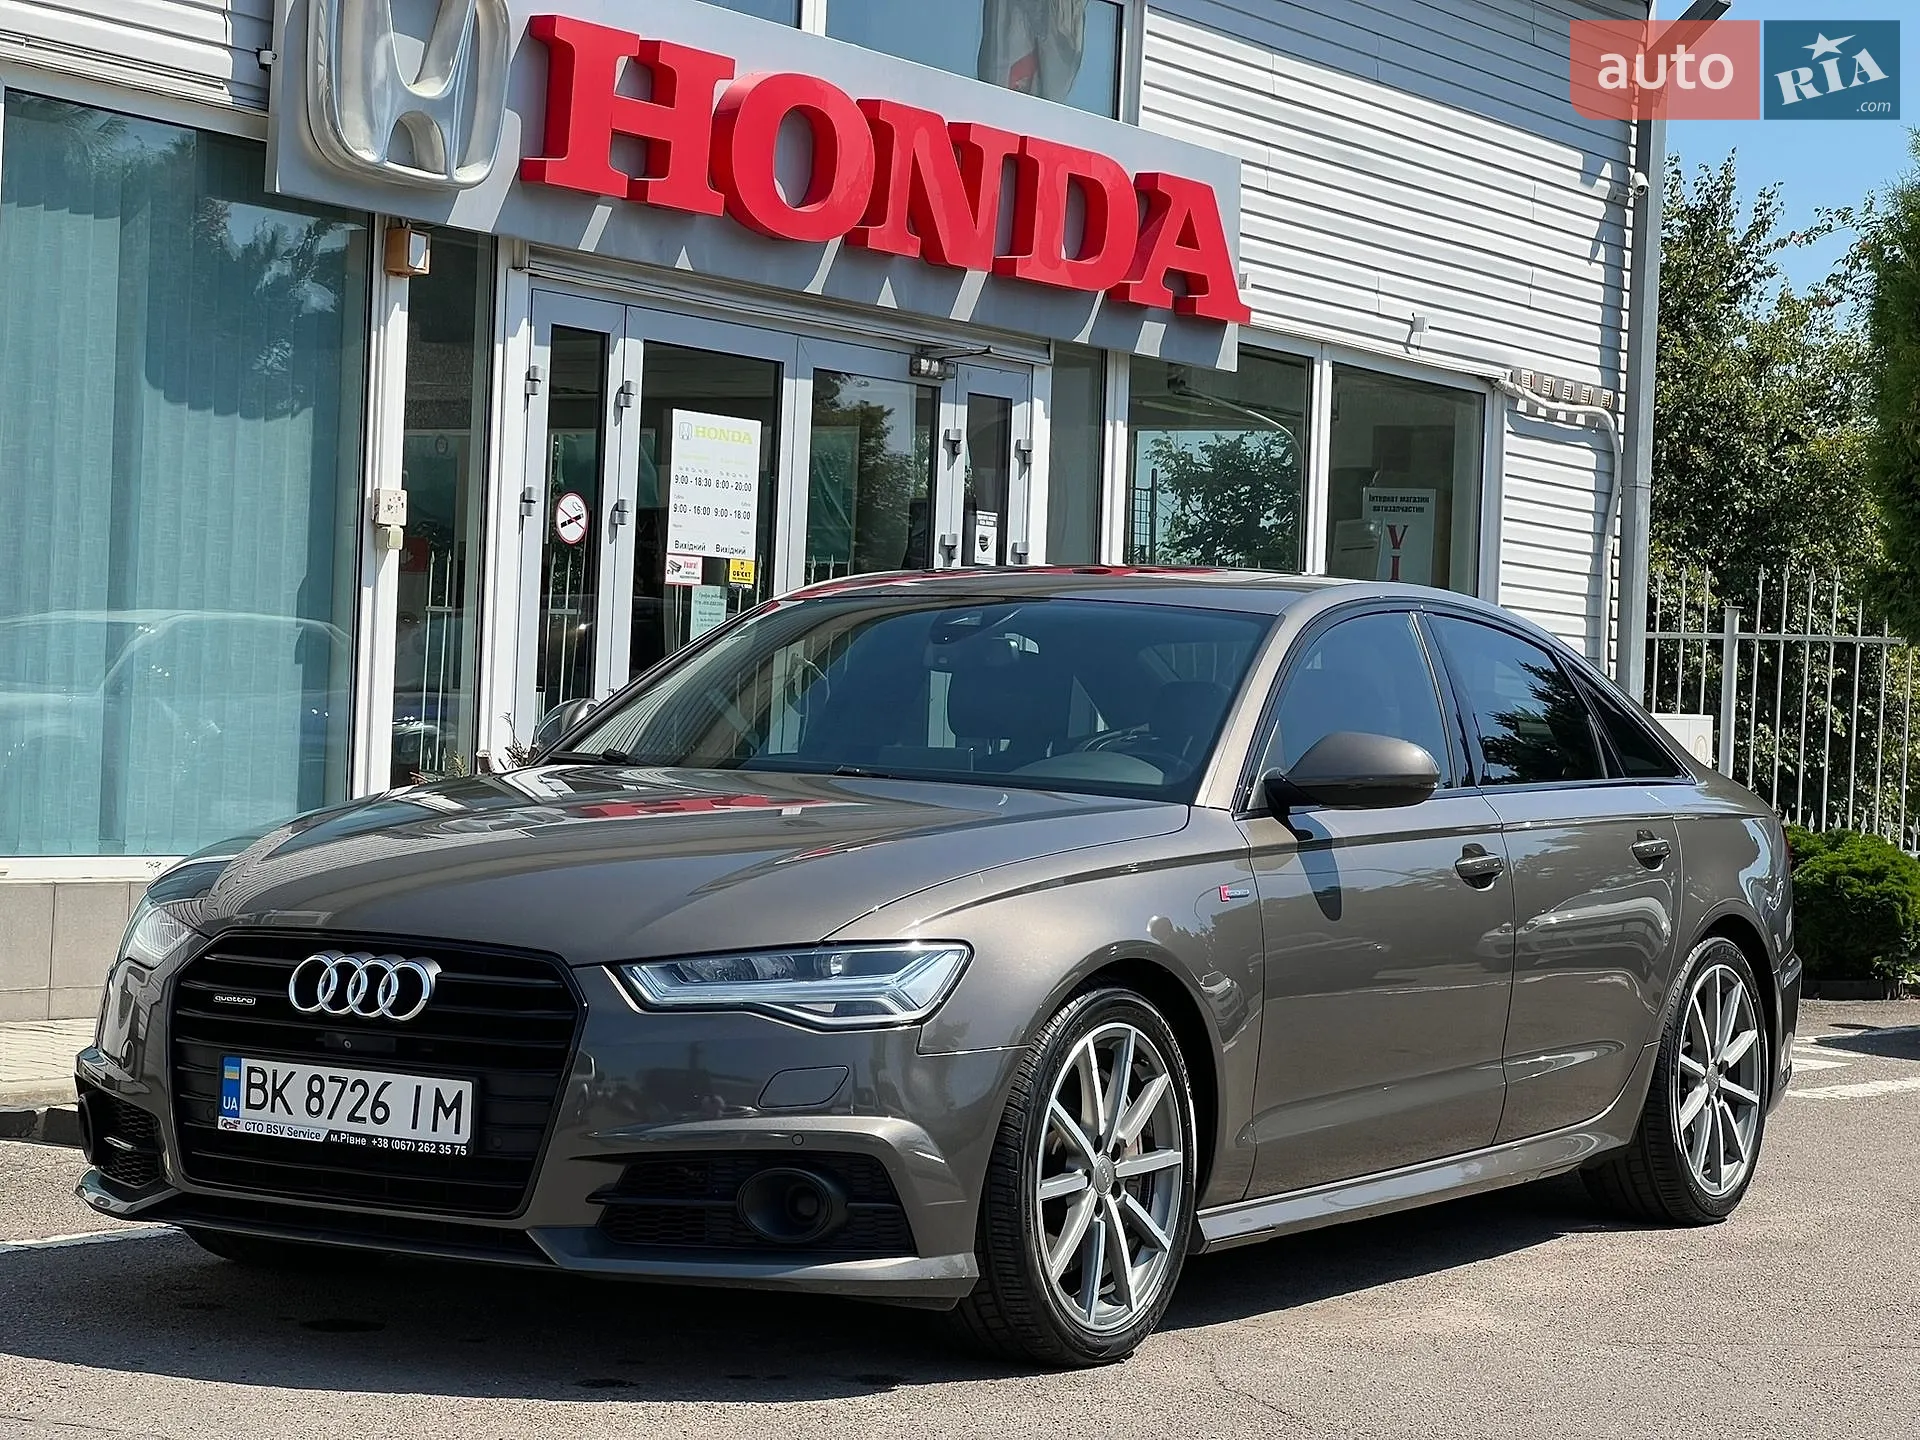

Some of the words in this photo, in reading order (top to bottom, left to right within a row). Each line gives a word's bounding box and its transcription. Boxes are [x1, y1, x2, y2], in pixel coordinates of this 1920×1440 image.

[520, 14, 1251, 324] HONDA
[694, 426, 753, 444] HONDA
[674, 540, 706, 552] Вихідний
[715, 543, 746, 555] Вихідний
[214, 994, 254, 1004] quattro
[222, 1095, 238, 1111] UA
[245, 1066, 296, 1115] BK
[305, 1074, 392, 1125] 8726
[266, 1124, 286, 1135] BSV
[287, 1127, 321, 1140] Service
[330, 1133, 367, 1146] м.Рівне
[371, 1138, 389, 1149] +38
[391, 1140, 416, 1151] (067)
[418, 1142, 436, 1154] 262
[438, 1144, 452, 1155] 35
[454, 1145, 467, 1156] 75
